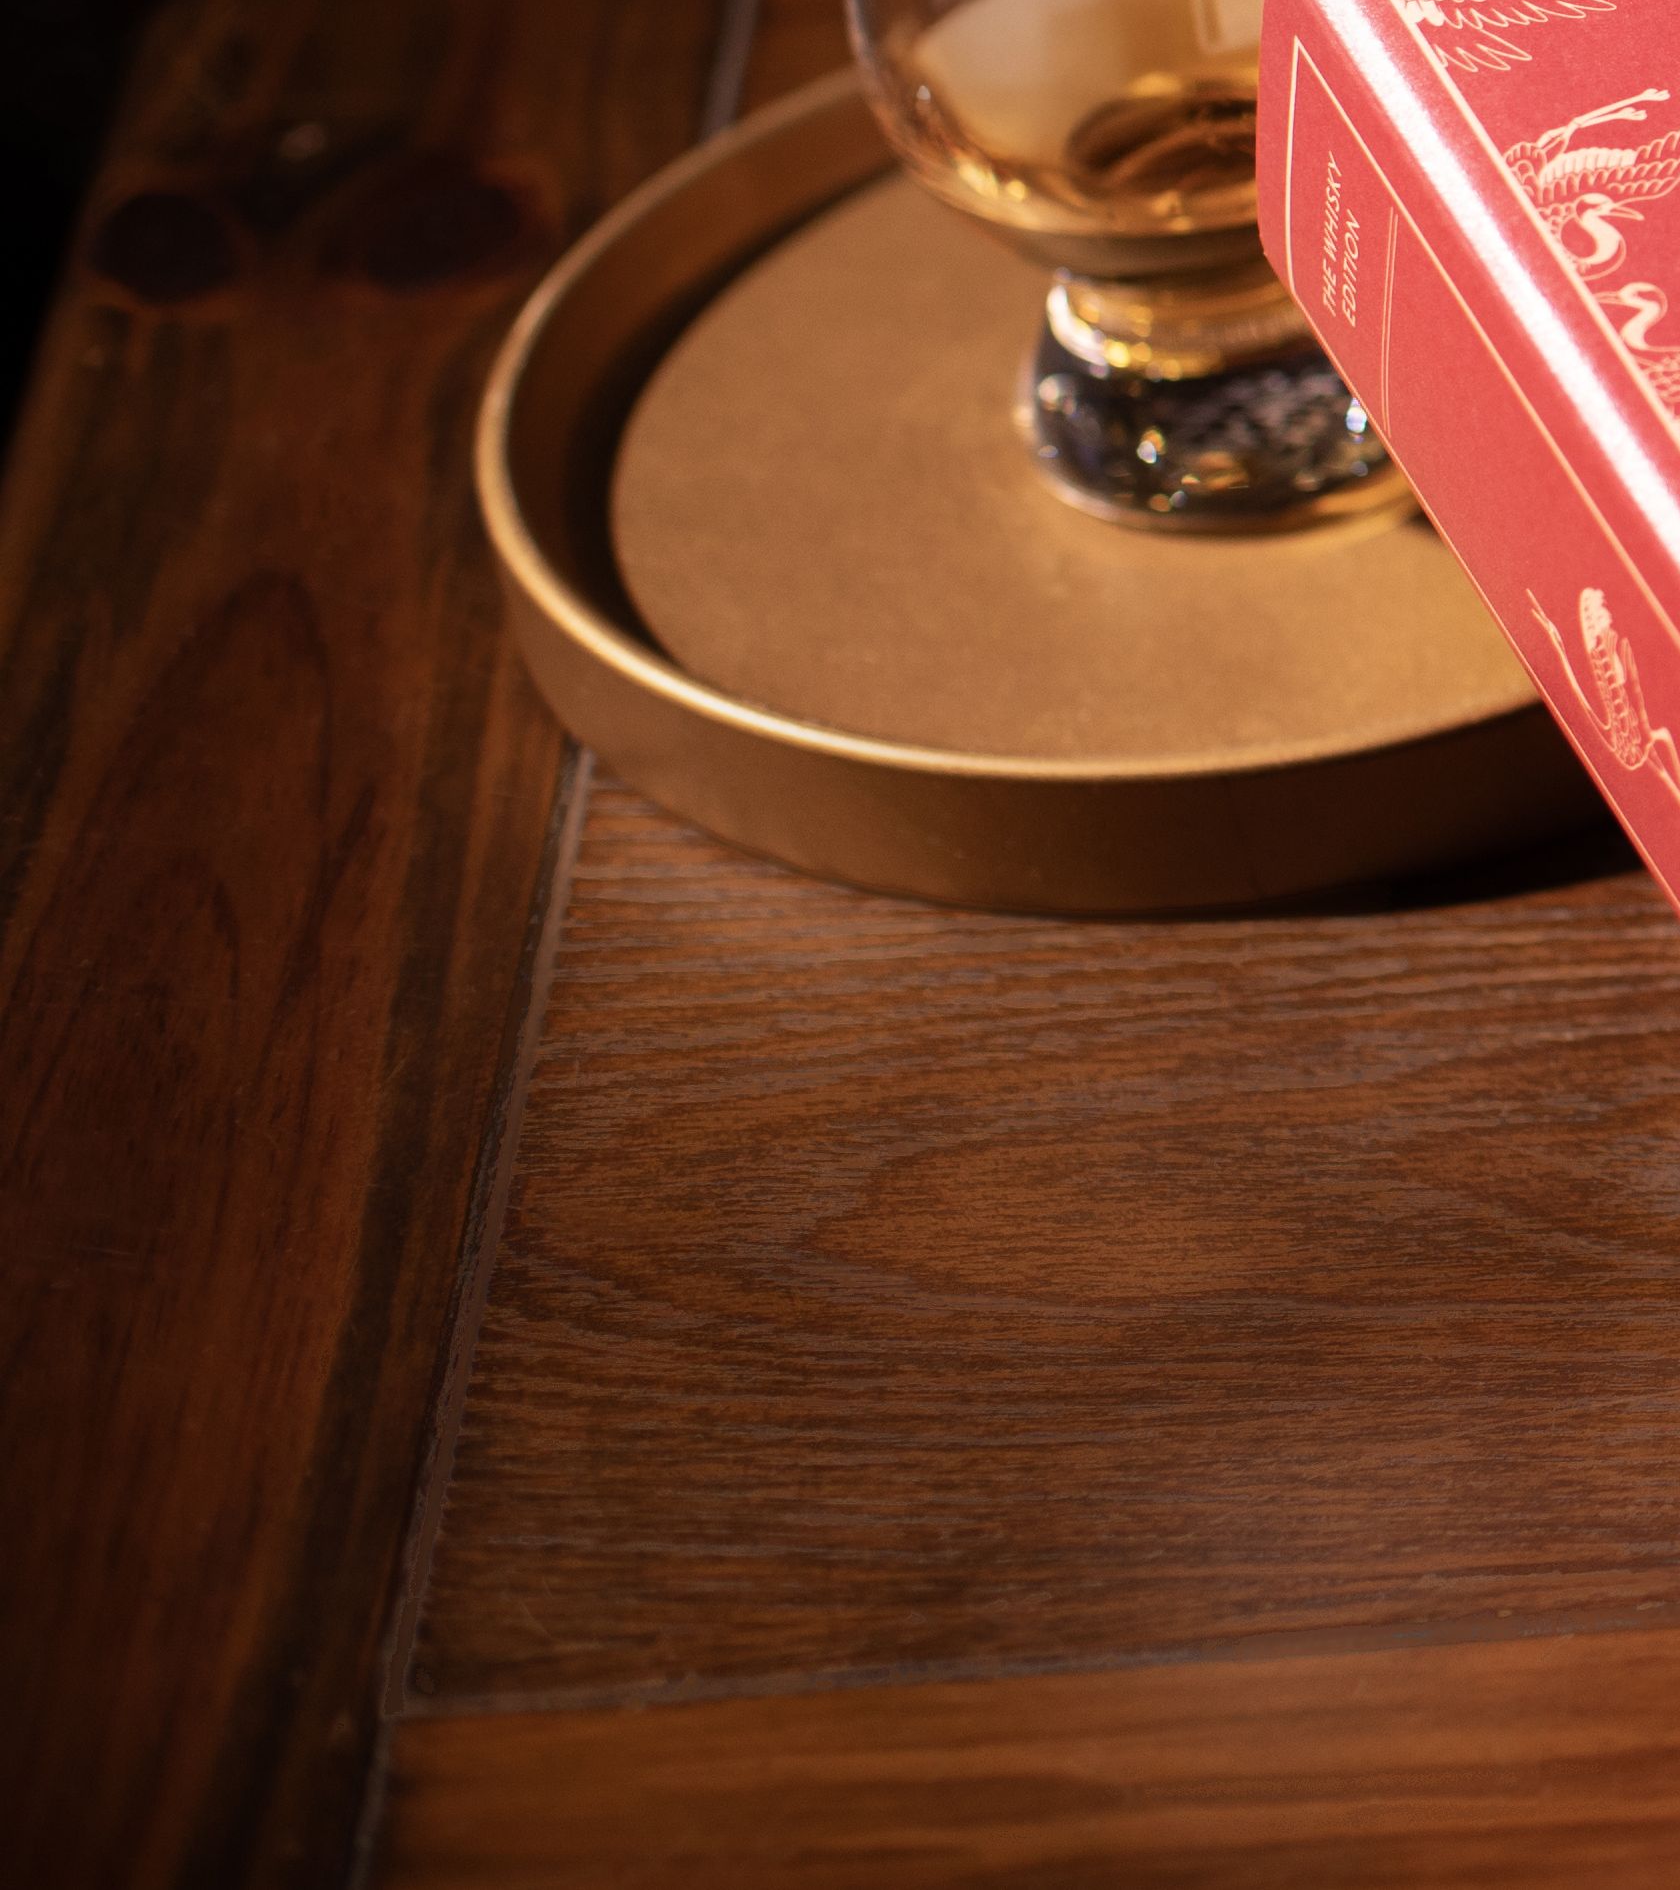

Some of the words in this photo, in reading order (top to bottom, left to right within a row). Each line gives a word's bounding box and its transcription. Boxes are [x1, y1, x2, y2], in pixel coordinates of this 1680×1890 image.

[1322, 151, 1343, 259] WHISKY
[1322, 262, 1337, 317] THE
[1341, 209, 1360, 328] EDITION
